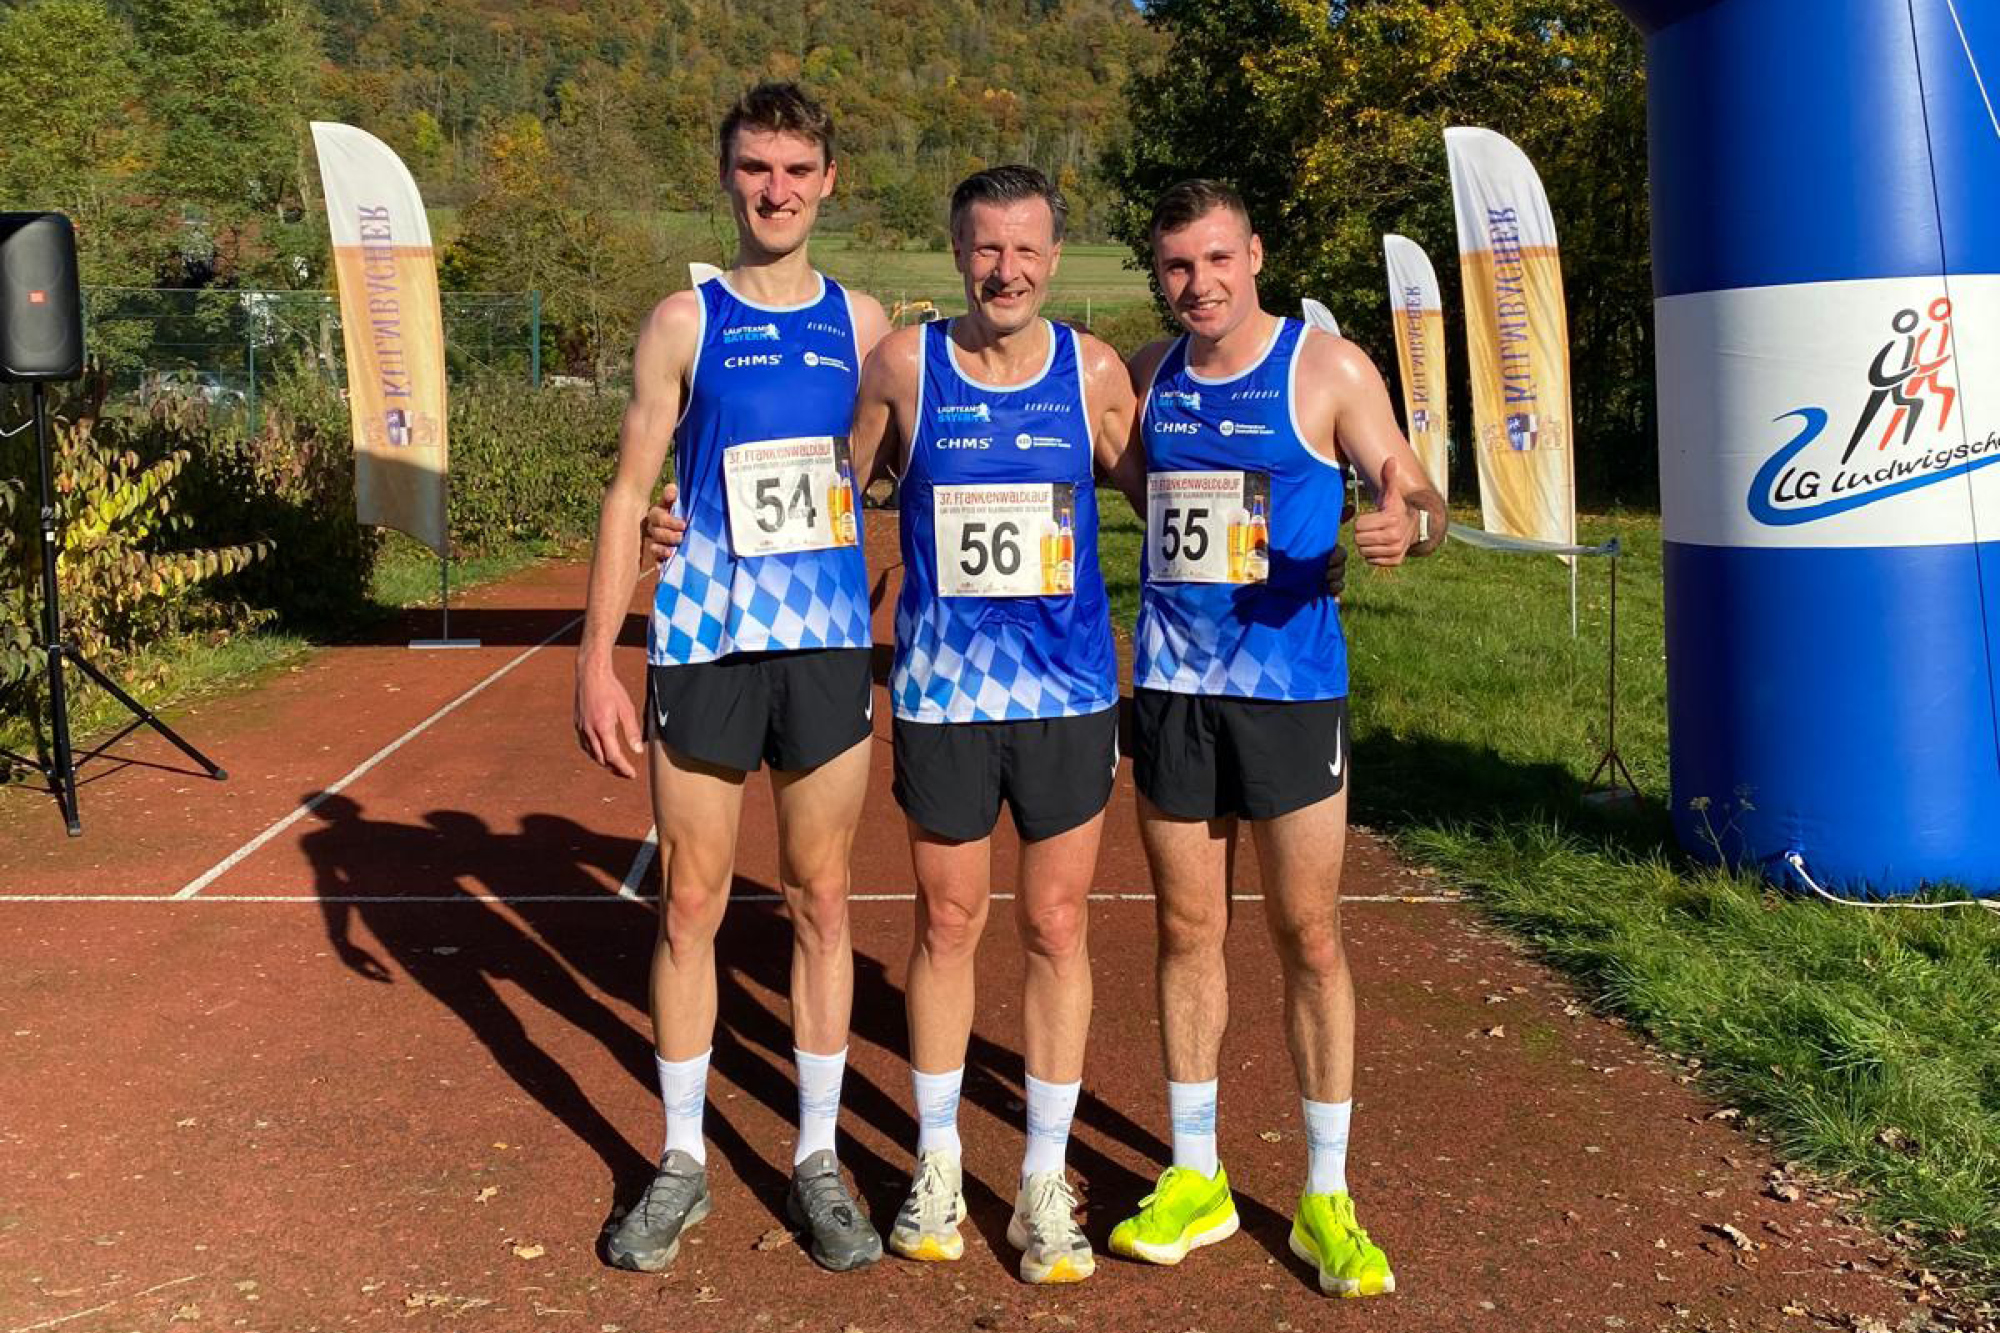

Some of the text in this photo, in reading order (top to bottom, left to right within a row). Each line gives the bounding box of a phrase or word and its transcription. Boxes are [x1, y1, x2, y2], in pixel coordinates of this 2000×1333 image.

[1774, 431, 2000, 502] LG Ludwigsch
[756, 473, 817, 533] 54
[960, 521, 1020, 576] 56
[1162, 508, 1209, 561] 55
